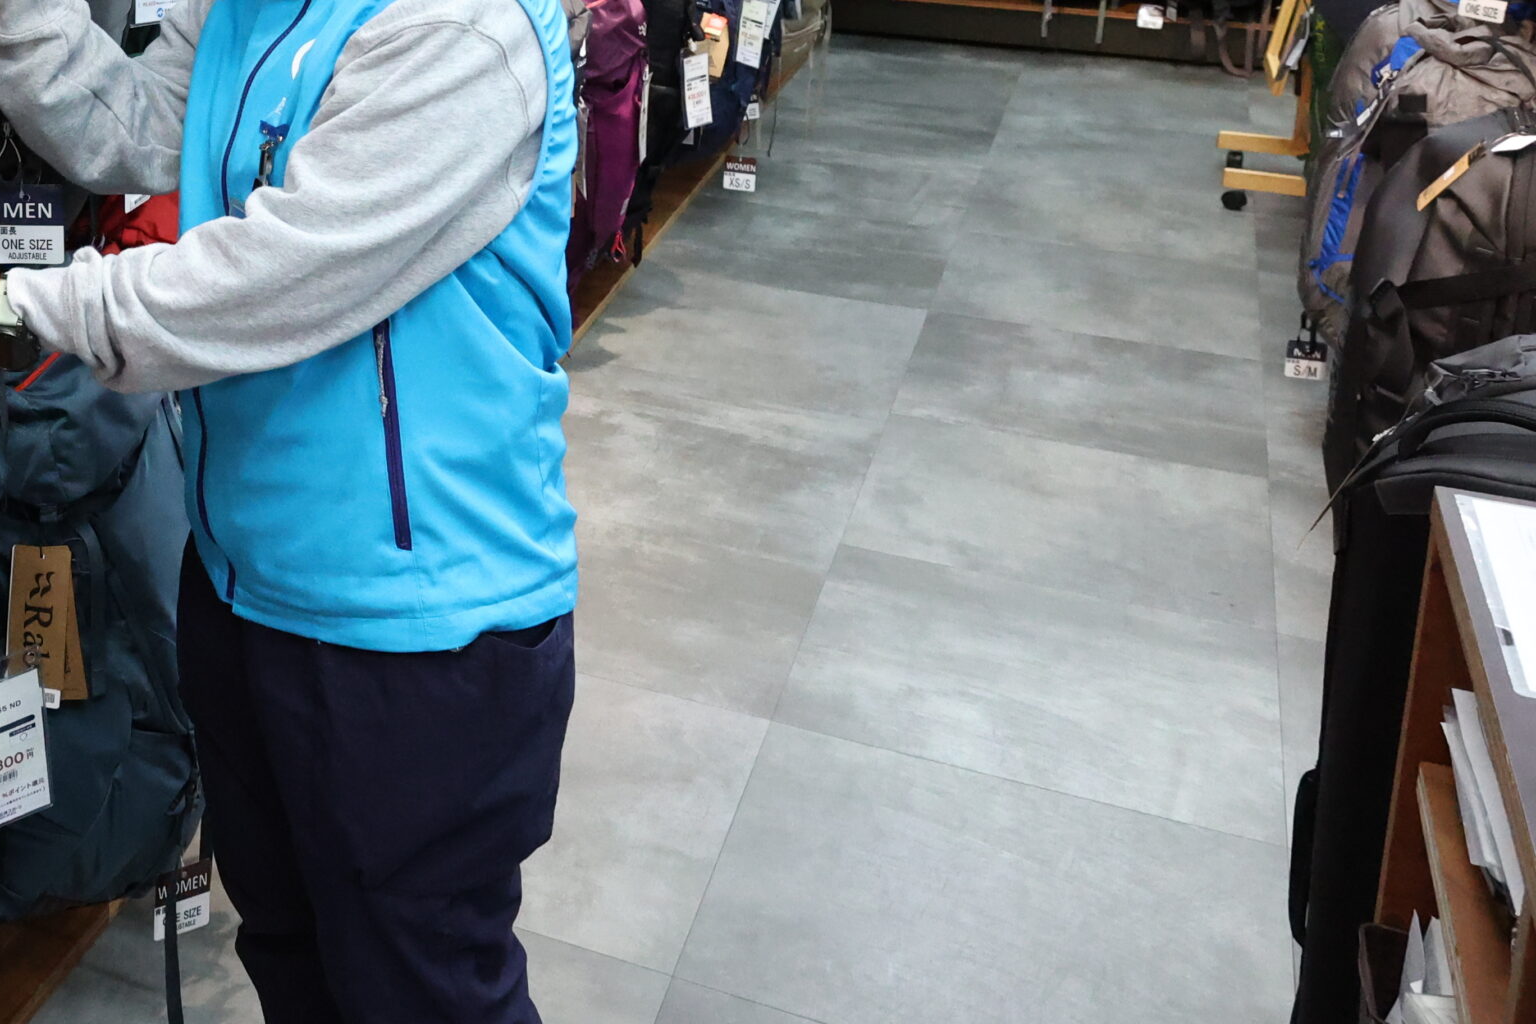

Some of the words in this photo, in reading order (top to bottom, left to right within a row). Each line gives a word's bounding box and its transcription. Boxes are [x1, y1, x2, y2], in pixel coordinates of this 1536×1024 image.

[1482, 5, 1499, 19] SIZE
[726, 162, 756, 173] WOMEN
[729, 176, 751, 189] XS/S
[3, 202, 52, 219] MEN
[1, 238, 25, 250] ONE
[29, 239, 53, 251] SIZE
[7, 252, 47, 261] ADJUSTABLE
[9, 699, 22, 709] ND
[183, 905, 202, 921] SIZE
